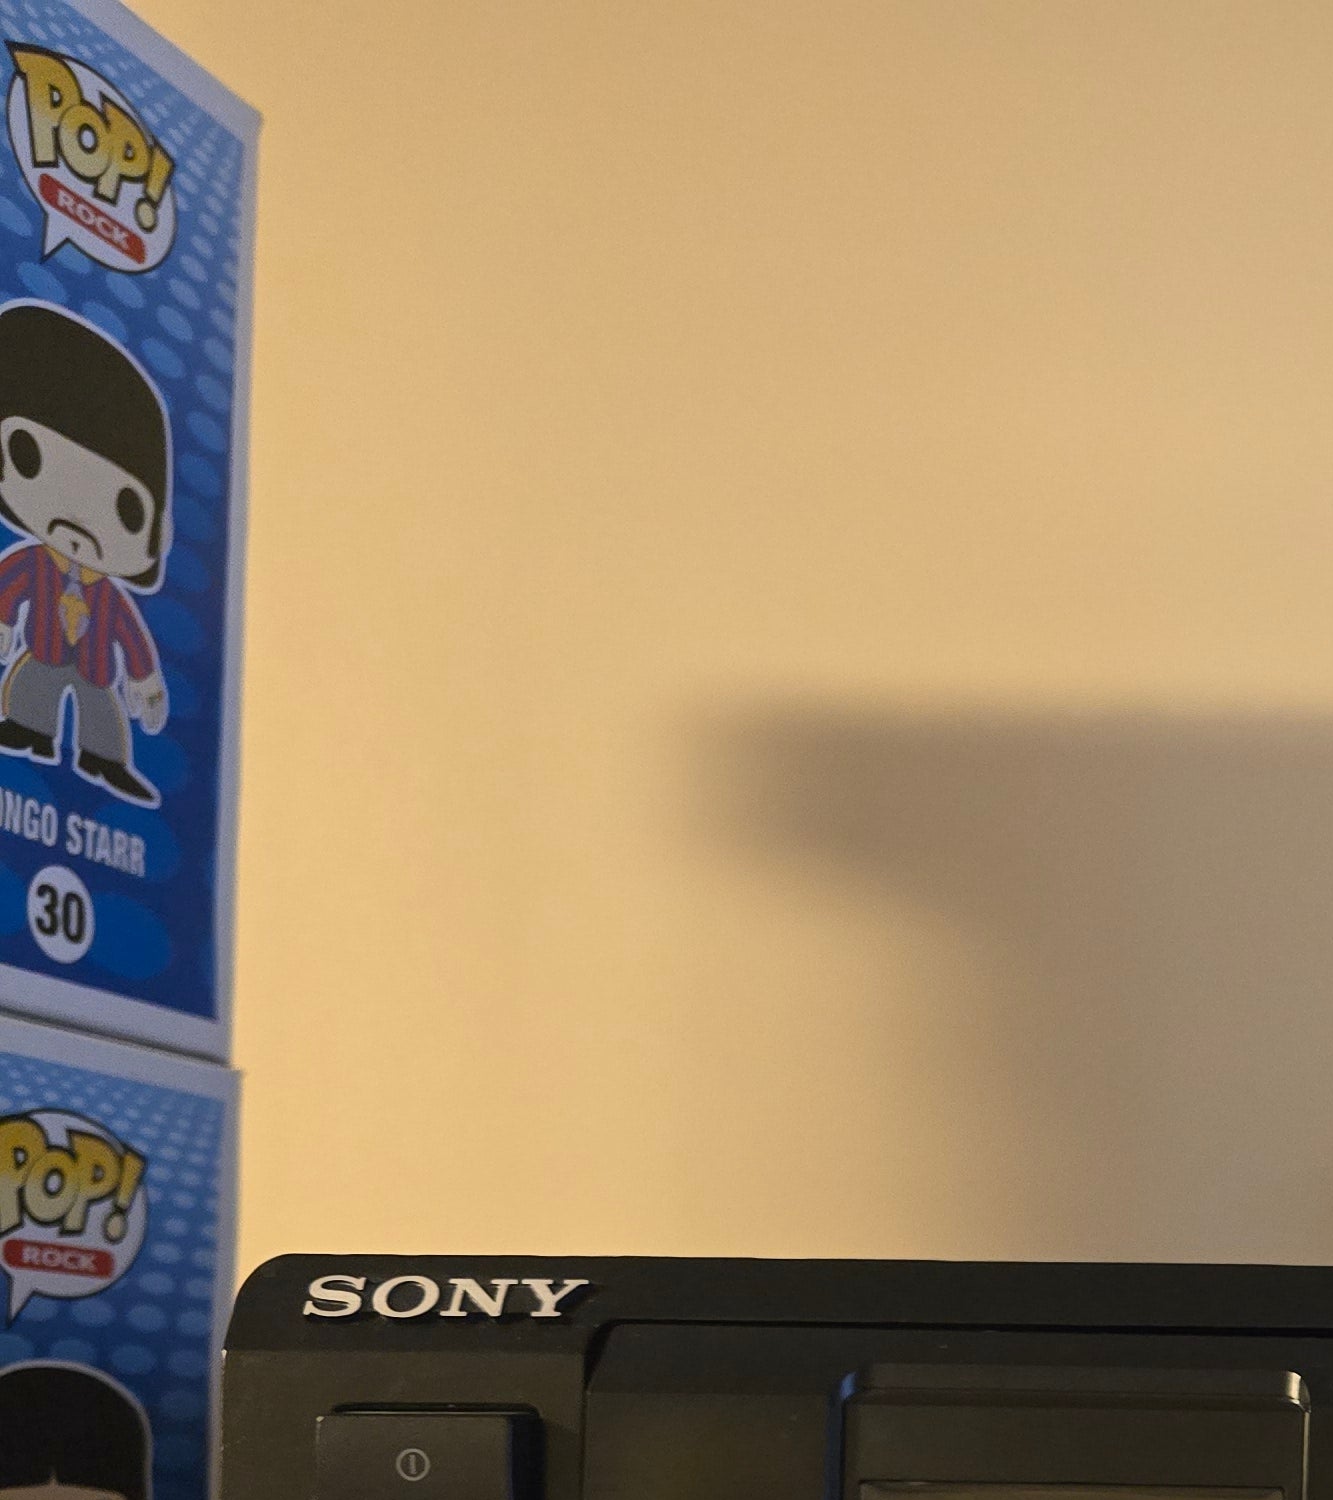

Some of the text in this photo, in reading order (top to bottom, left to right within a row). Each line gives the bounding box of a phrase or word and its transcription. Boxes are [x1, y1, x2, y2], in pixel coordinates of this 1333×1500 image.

[5, 39, 175, 233] POP!
[57, 188, 130, 250] ROCK
[66, 812, 147, 878] STARR
[36, 883, 86, 943] 30
[22, 1246, 98, 1269] ROCK
[303, 1274, 589, 1318] SONY
